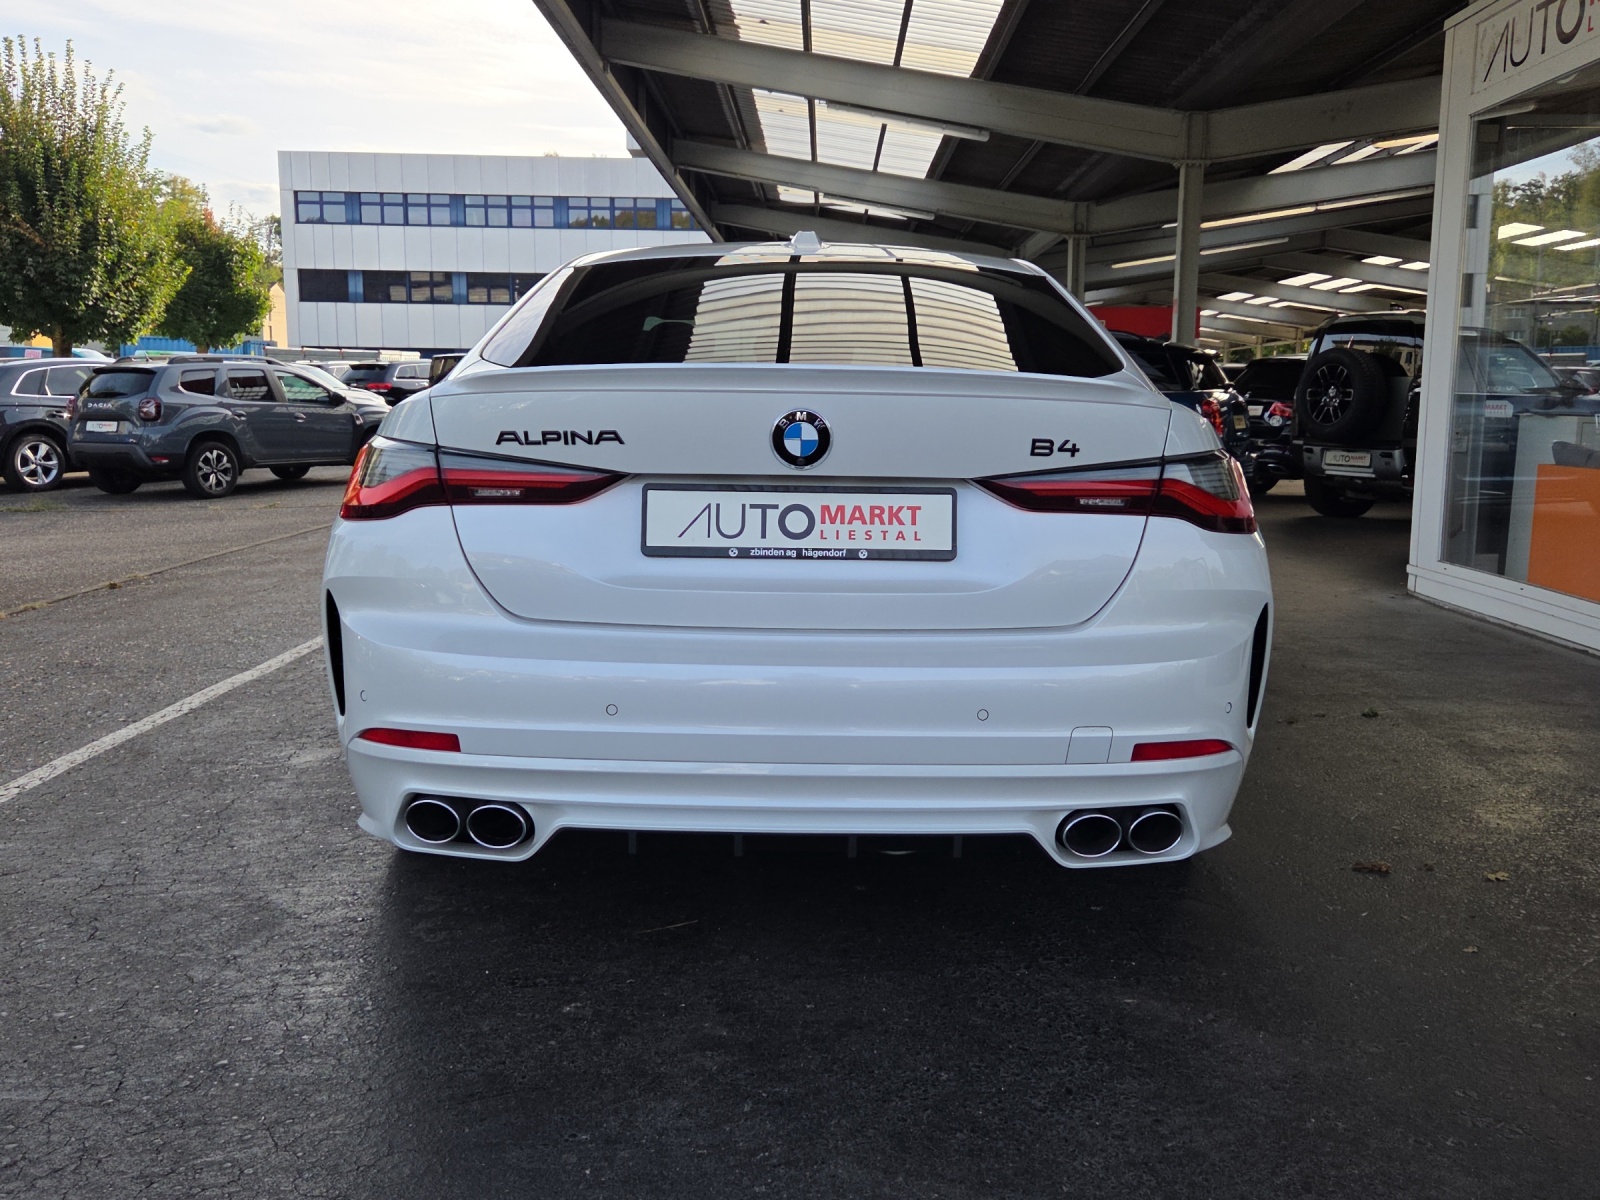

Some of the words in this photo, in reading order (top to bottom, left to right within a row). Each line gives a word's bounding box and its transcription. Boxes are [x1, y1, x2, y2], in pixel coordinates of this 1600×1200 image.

[1483, 0, 1586, 82] AUTO
[778, 411, 826, 430] BMW
[495, 430, 625, 446] ALPINA
[1030, 438, 1080, 457] B4
[678, 502, 816, 541] AUTO
[820, 504, 922, 526] MARKT
[820, 529, 922, 541] LIESTAL
[750, 548, 785, 556] zbinden
[786, 549, 797, 558] ag
[802, 548, 847, 558] hägendorf
